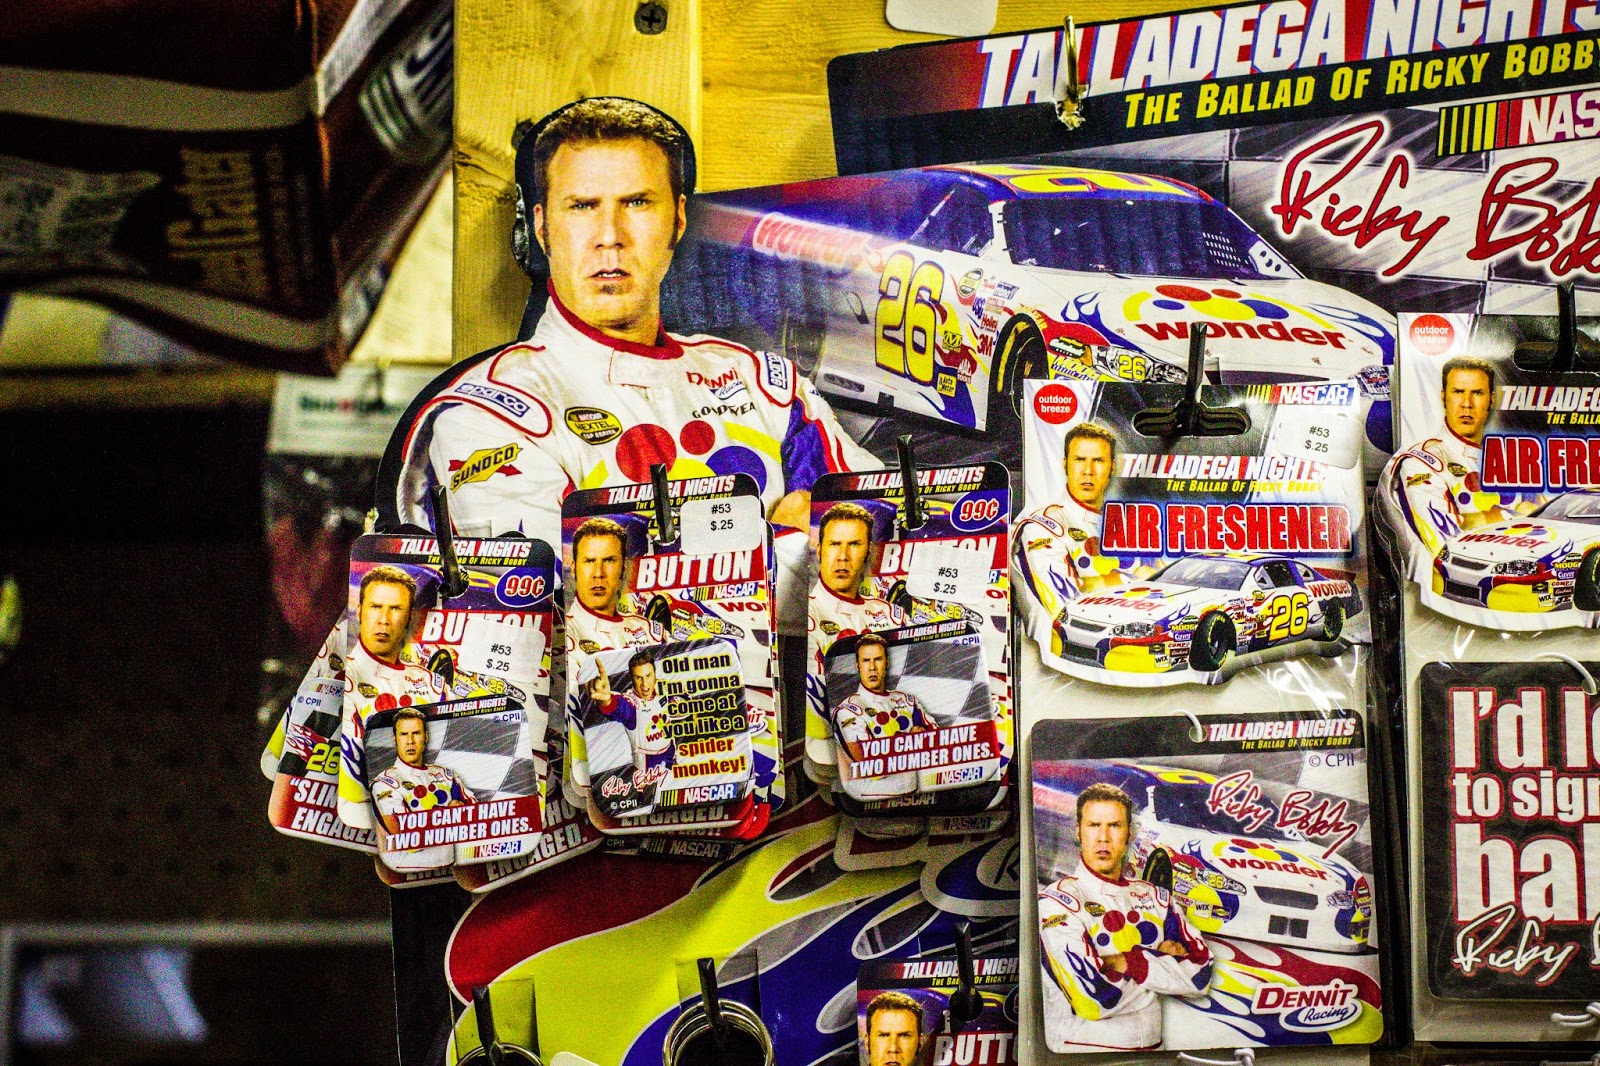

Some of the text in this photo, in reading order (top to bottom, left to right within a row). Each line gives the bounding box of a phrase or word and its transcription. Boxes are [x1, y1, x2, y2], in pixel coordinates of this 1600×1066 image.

[1125, 38, 1600, 128] THE BALLAD OF RICKY BOBB
[875, 249, 945, 387] 26
[1414, 326, 1448, 336] outdoor
[1418, 335, 1448, 344] breeze
[977, 333, 994, 357] 3M
[1119, 354, 1146, 381] 26
[1038, 395, 1073, 405] outdoor
[1279, 386, 1350, 405] NASCAR
[1041, 405, 1070, 414] breeze
[1547, 412, 1566, 424] THE
[1309, 425, 1330, 438] #53
[1304, 440, 1329, 453] $.25
[452, 445, 515, 488] SUNOCO
[1121, 454, 1327, 480] TALLADEGA NIGHTS
[1482, 437, 1543, 487] AIR
[933, 466, 985, 486] NIGHTS
[684, 475, 736, 497] NIGHTS
[884, 488, 896, 497] THE
[924, 486, 933, 494] OF
[935, 484, 956, 493] RICKY
[958, 483, 981, 491] BOBBY
[1167, 480, 1184, 491] THE
[1189, 480, 1228, 492] BALLAD
[1232, 481, 1246, 492] OF
[1249, 481, 1283, 492] RICKY
[636, 501, 648, 510] THE
[711, 504, 731, 514] #53
[960, 498, 1000, 521] 99¢
[710, 520, 734, 531] $.25
[1102, 503, 1351, 551] AIR FRESHENER
[478, 540, 531, 557] NIGHTS
[1457, 533, 1550, 548] wonder
[428, 555, 440, 563] THE
[469, 557, 479, 565] OF
[480, 557, 502, 565] RICKY
[503, 557, 527, 566] BOBBY
[636, 550, 753, 590] BUTTON
[938, 567, 958, 578] #53
[505, 575, 545, 598] 99¢
[712, 584, 757, 599] NASCAR
[933, 582, 957, 594] $.25
[1309, 582, 1351, 598] wonder
[947, 605, 961, 619] 26
[1077, 596, 1168, 612] wonder
[1269, 592, 1309, 641] 26
[707, 619, 721, 633] 26
[897, 625, 937, 640] TALLADEGA
[938, 620, 967, 632] NIGHTS
[491, 643, 511, 655] #53
[962, 637, 980, 646] CPII
[486, 658, 510, 672] $.25
[662, 654, 731, 674] Old man
[489, 679, 504, 693] 26
[659, 674, 740, 695] I'm gonna
[437, 697, 507, 715] TALLADEGA NIGHTS
[667, 694, 735, 716] come at
[503, 712, 520, 722] CPII
[663, 722, 694, 739] you
[698, 717, 730, 733] like
[734, 716, 744, 729] a
[1209, 718, 1356, 742] TALLADEGA NIGHTS
[1451, 690, 1544, 768] I'd
[679, 737, 734, 757] spider
[862, 725, 977, 758] YOU CAN'T HAVE
[1241, 737, 1352, 749] THE BALLAD OF RICKY BOBBY
[306, 742, 340, 775] 26
[673, 755, 746, 778] monkey!
[851, 743, 995, 779] TWO NUMBER ONES.
[1325, 754, 1355, 767] CPII
[941, 767, 983, 784] NASCAR
[683, 784, 735, 804] NASCAR
[1453, 774, 1501, 817] to
[399, 800, 516, 831] YOU CAN'T HAVE
[386, 816, 533, 851] TWO NUMBER ONES.
[479, 841, 520, 858] NASCAR
[1219, 857, 1329, 882] wonder
[1208, 873, 1224, 889] 26
[932, 977, 945, 986] THE
[974, 976, 983, 984] OF
[1303, 1004, 1350, 1024] Racing
